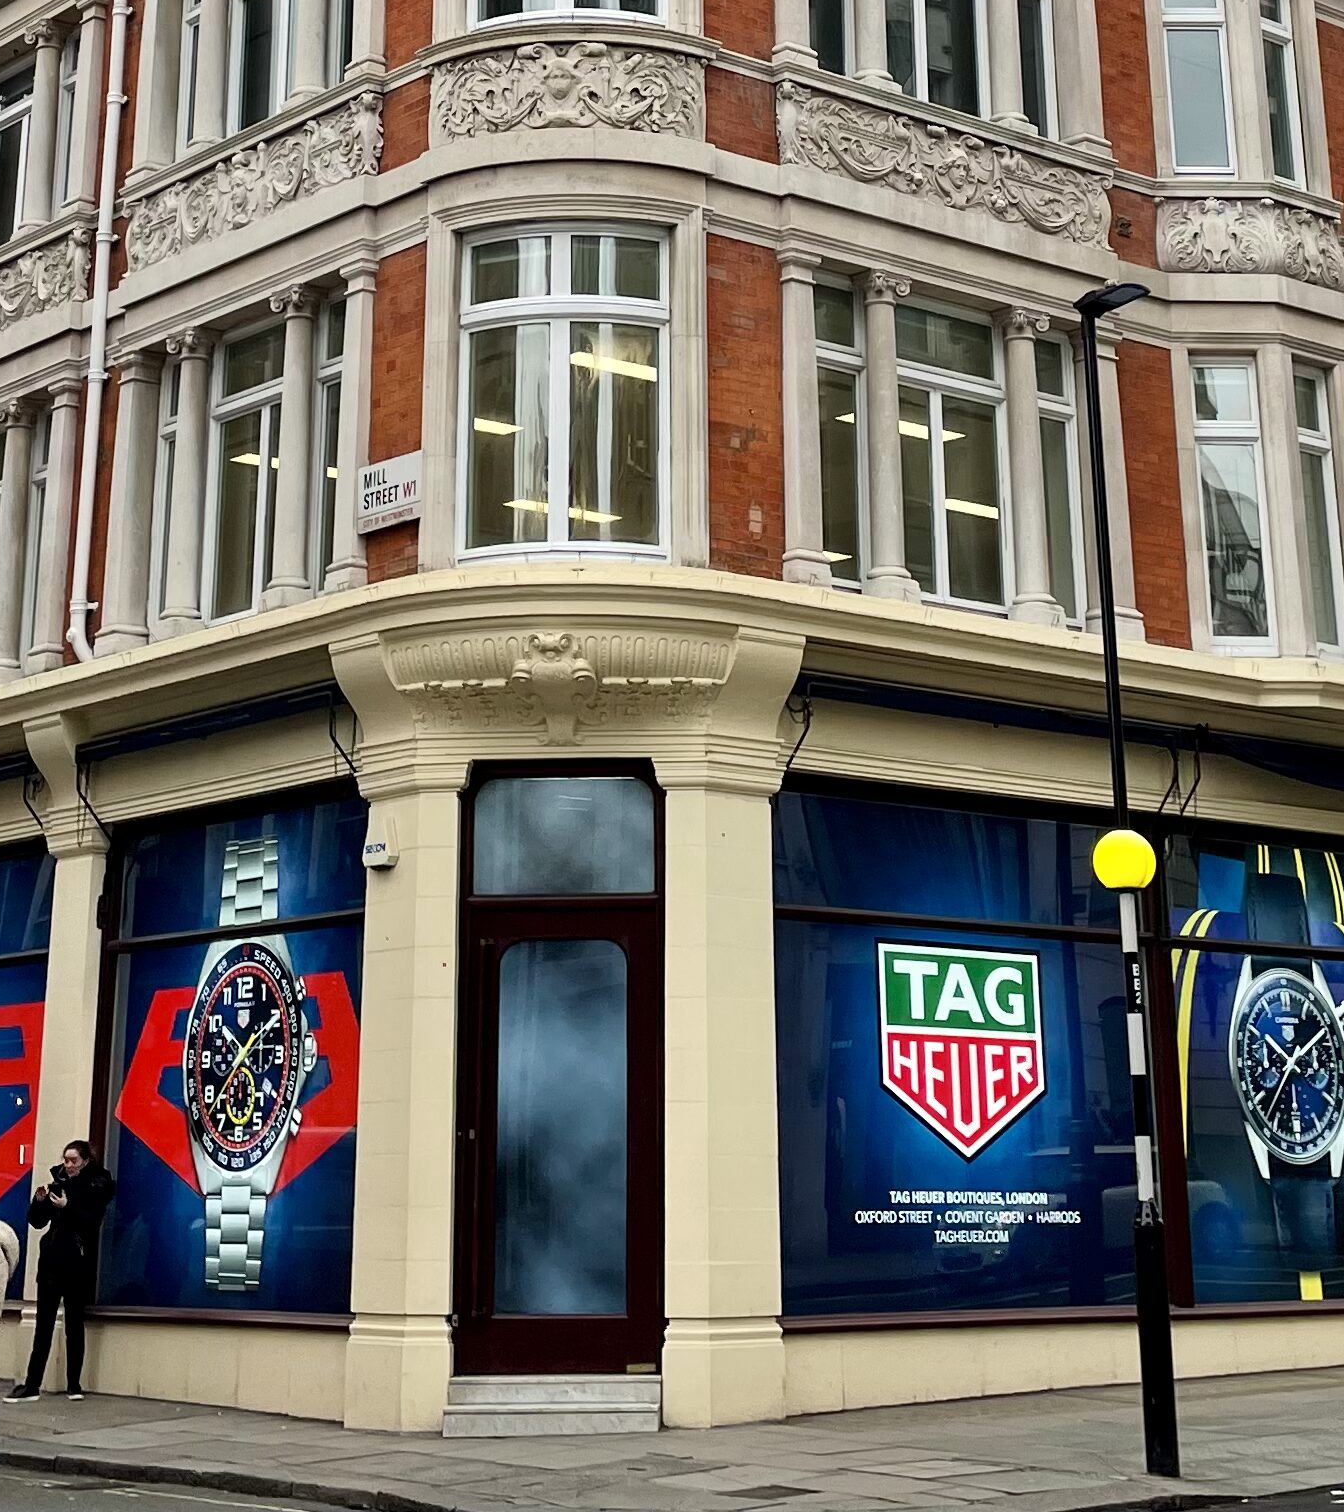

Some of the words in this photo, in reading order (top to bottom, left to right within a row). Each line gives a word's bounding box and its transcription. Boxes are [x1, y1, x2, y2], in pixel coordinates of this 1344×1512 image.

[364, 468, 388, 490] MILL
[363, 485, 399, 510] STREET
[402, 479, 417, 498] W1
[254, 949, 282, 980] SPEED
[223, 986, 232, 1006] 11
[236, 976, 254, 999] 12
[892, 959, 1026, 1027] TAG
[208, 1015, 223, 1033] 10
[201, 1050, 211, 1069] 9
[274, 1045, 284, 1065] 3
[204, 1085, 215, 1104] 8
[891, 1039, 1034, 1138] HEUER
[252, 1112, 263, 1131] 5
[889, 1190, 910, 1204] TAG
[912, 1191, 945, 1204] HEUER
[946, 1191, 1005, 1206] BOUTIQUES,
[1006, 1192, 1049, 1205] LONDON
[854, 1211, 897, 1224] OXFORD
[899, 1211, 933, 1224] STREET
[945, 1211, 984, 1224] COVENT
[987, 1211, 1025, 1225] GARDEN
[1036, 1211, 1081, 1224] HARRODS
[934, 1230, 1010, 1243] TAGHEUER.COM
